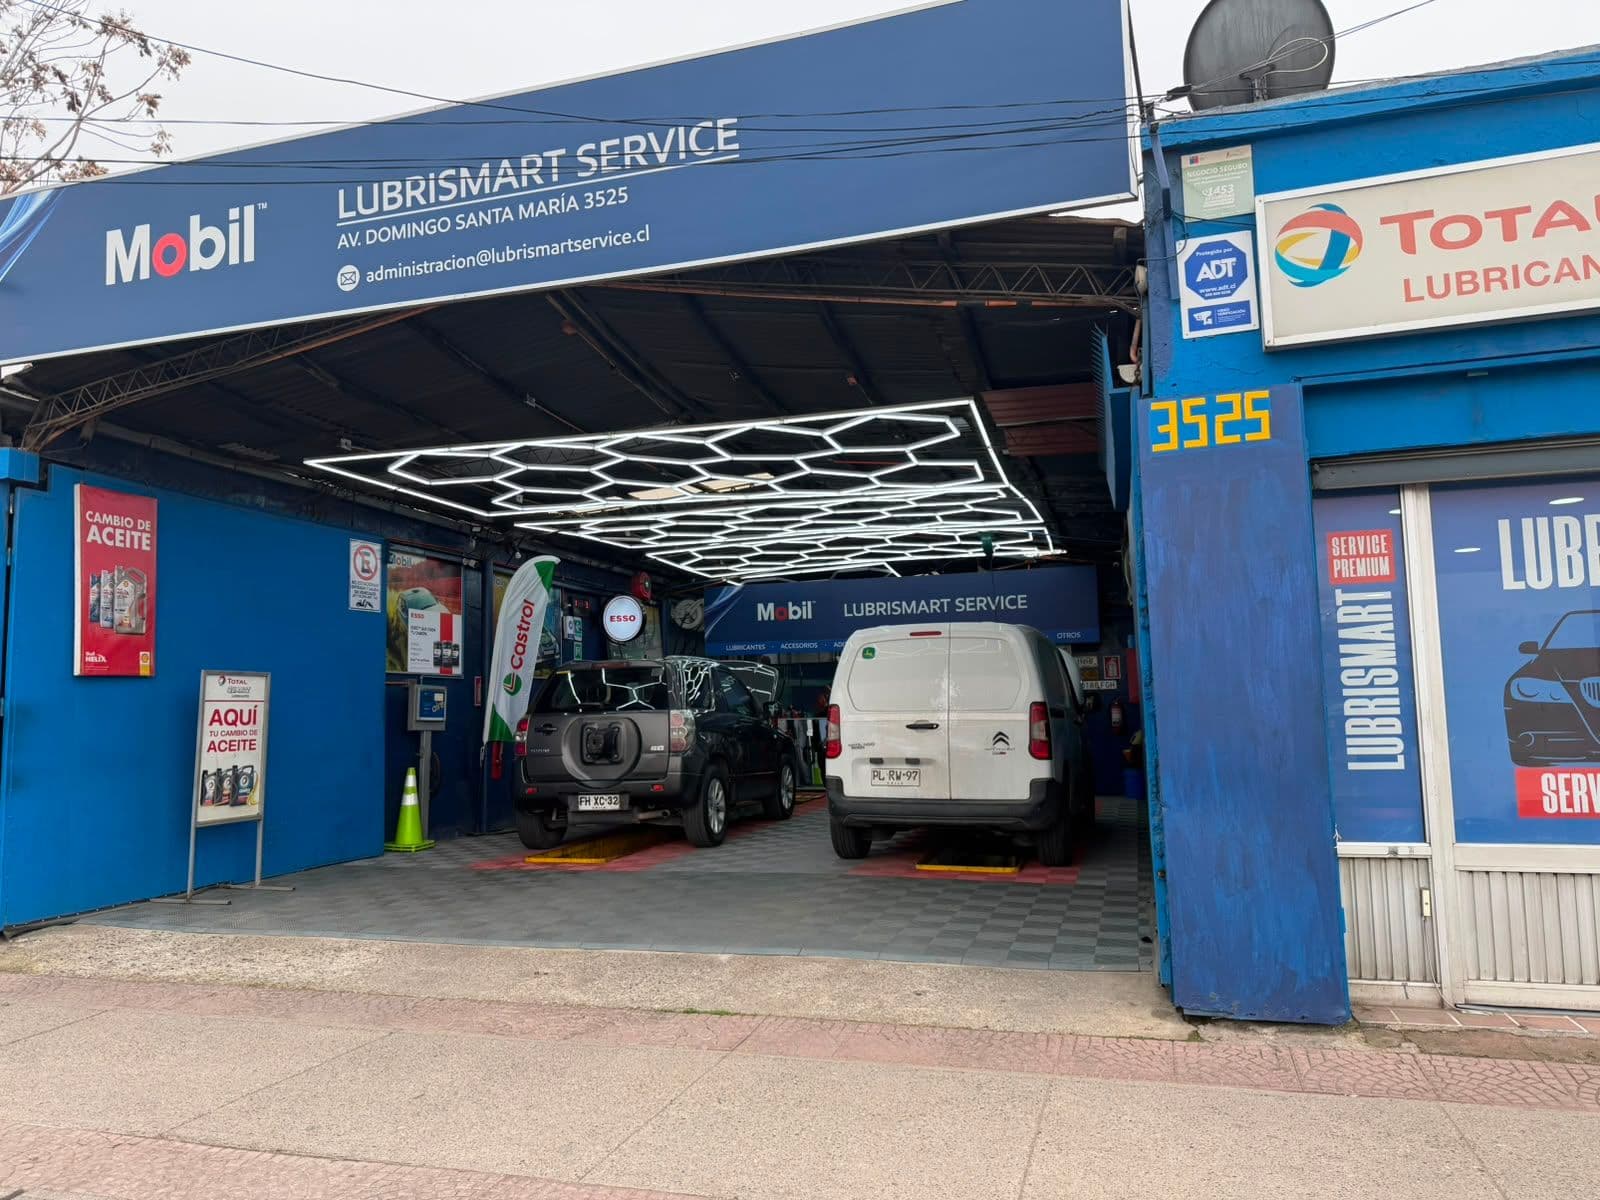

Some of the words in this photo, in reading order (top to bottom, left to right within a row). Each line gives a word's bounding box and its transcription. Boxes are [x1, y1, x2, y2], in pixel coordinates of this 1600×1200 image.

[338, 149, 566, 219] LUBRISMART
[576, 118, 740, 178] SERVICE
[1219, 162, 1248, 173] SEGURO
[337, 230, 361, 249] AV.
[366, 217, 452, 245] DOMINGO
[455, 207, 514, 231] SANTA
[518, 193, 579, 219] MARÍA
[583, 186, 629, 208] 3525
[1379, 194, 1600, 255] TOTA
[105, 204, 256, 286] Mobil
[366, 225, 650, 283] administracion@lubrismartservice.cl
[1196, 257, 1237, 282] ADT
[1151, 390, 1271, 452] 3525
[86, 511, 134, 528] CAMBIO
[137, 518, 151, 530] DE
[86, 525, 151, 551] ACEITE
[1332, 534, 1388, 556] SERVICE
[1333, 556, 1390, 579] PREMIUM
[757, 600, 813, 622] Mobil
[843, 598, 951, 617] LUBRISMART
[955, 594, 1028, 612] SERVICE
[609, 615, 636, 623] ESSO
[510, 599, 535, 671] Castrol
[1056, 631, 1081, 640] OTROS
[725, 643, 766, 651] LUBRICANTES
[1335, 588, 1405, 771] LUBRISMART
[208, 705, 258, 727] AQUÍ
[207, 739, 257, 753] ACEITE
[579, 796, 591, 805] FH
